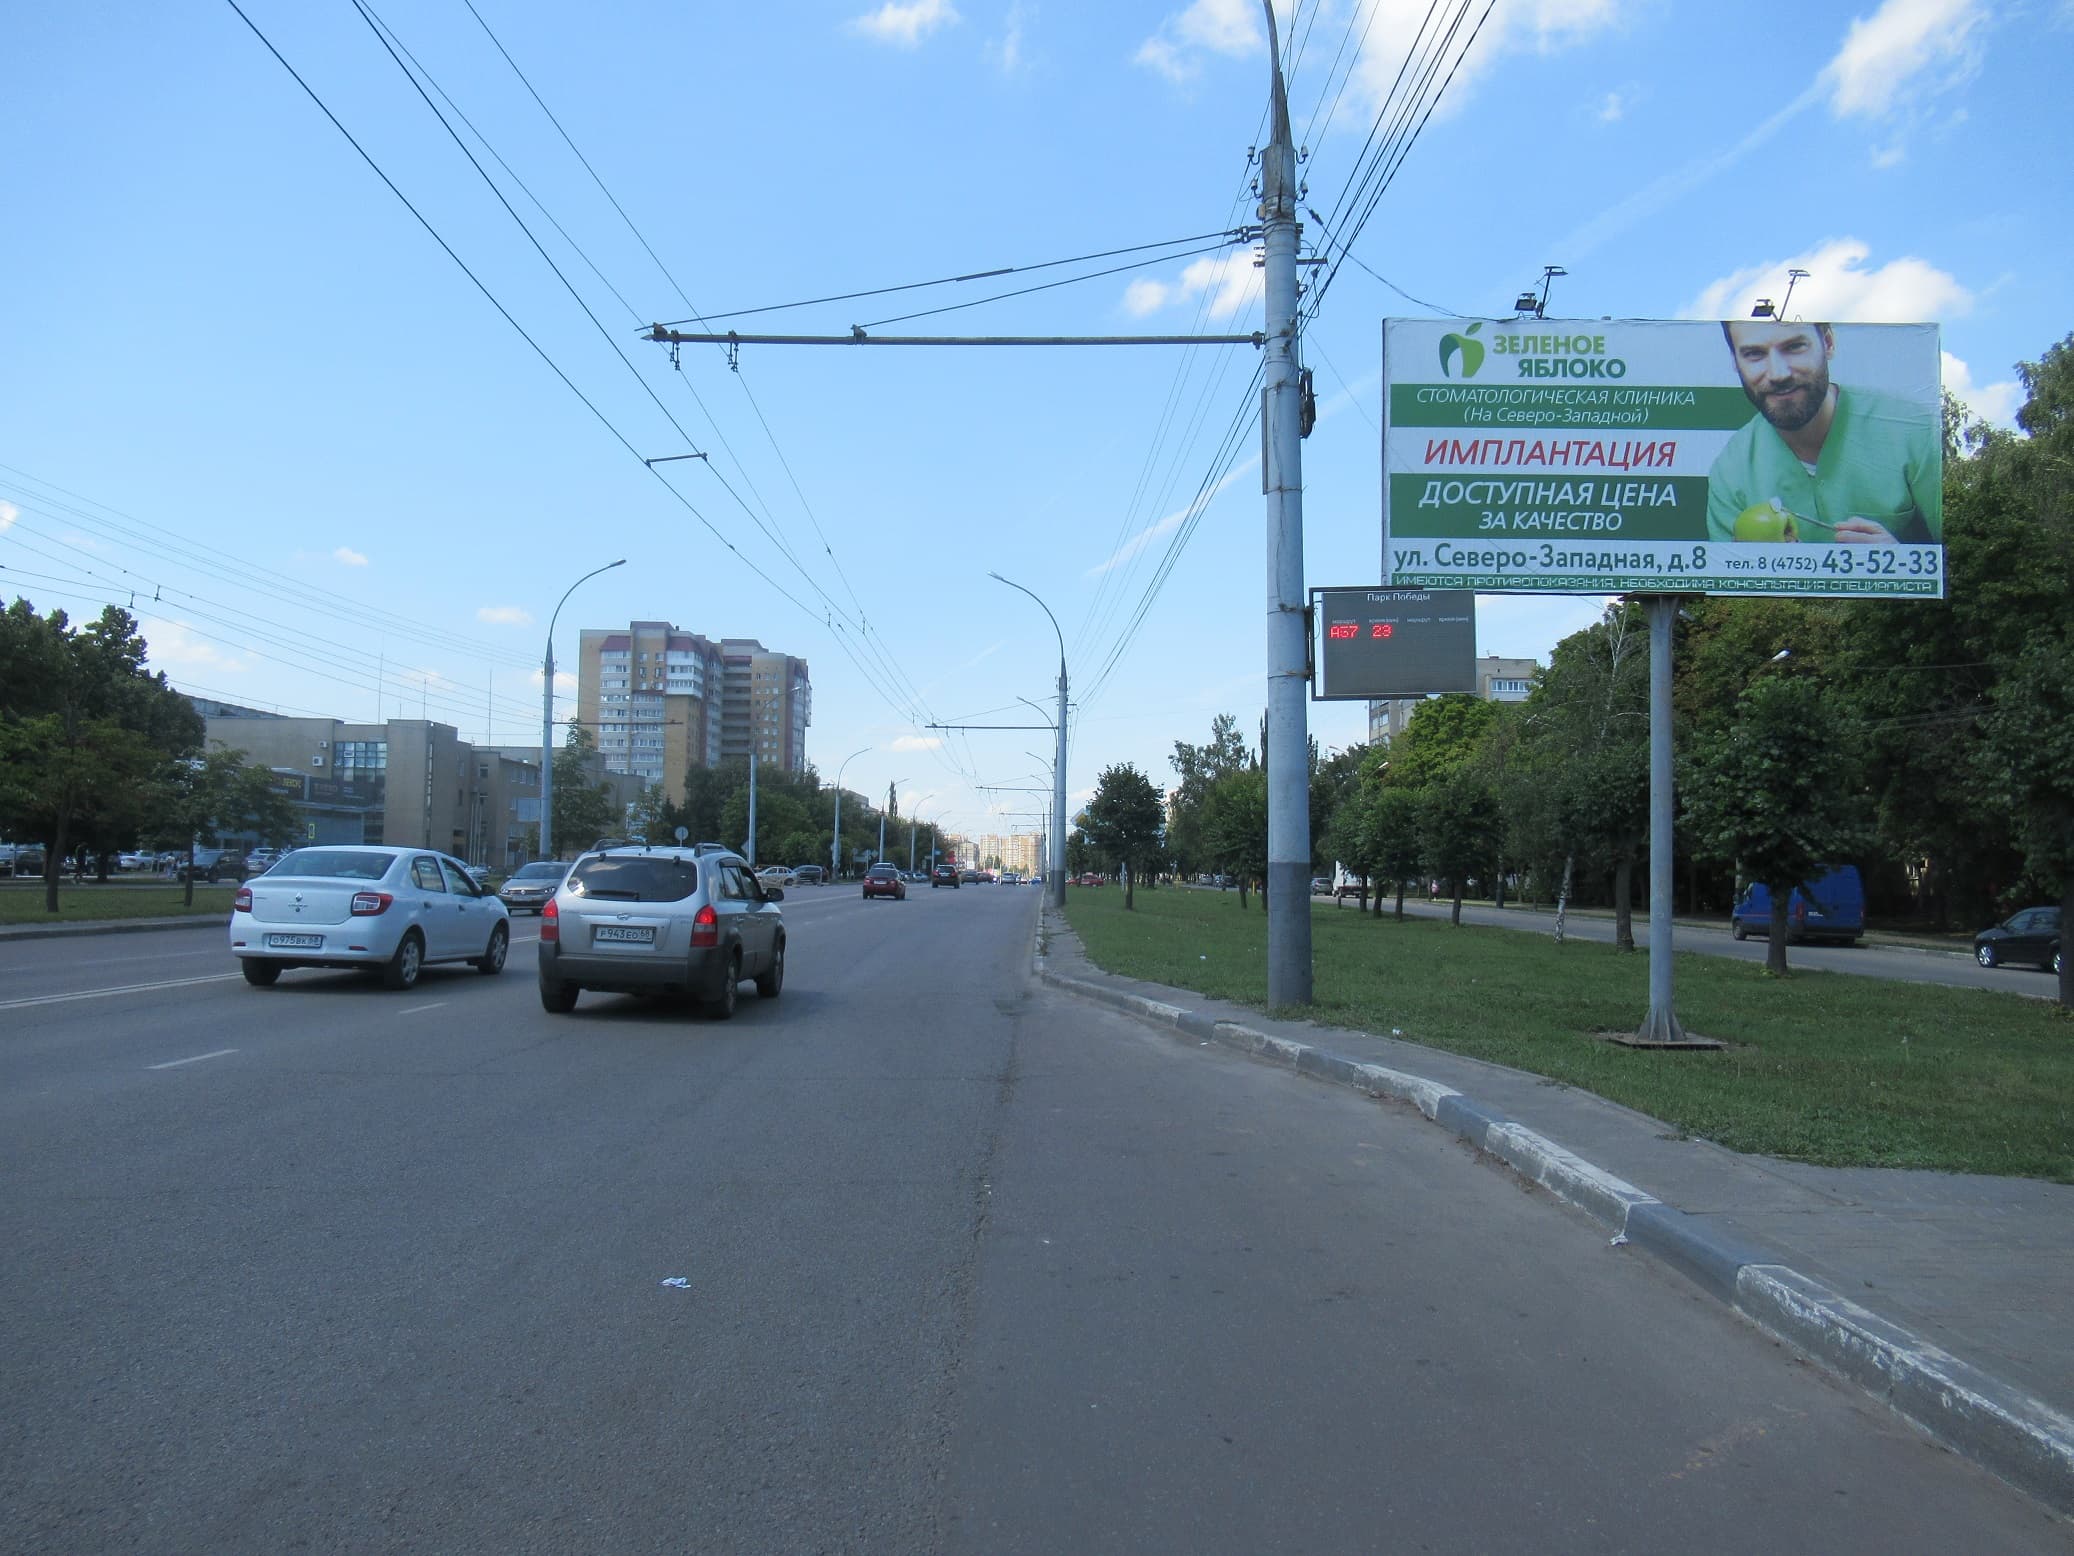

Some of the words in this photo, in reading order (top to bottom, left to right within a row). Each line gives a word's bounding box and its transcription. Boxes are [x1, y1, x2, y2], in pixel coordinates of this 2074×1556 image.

[1493, 335, 1605, 355] ЗЕЛЕНОЕ
[1518, 358, 1626, 378] ЯБЛОКО
[1416, 388, 1609, 405] СТОМАТОЛОГИЧЕСКАЯ
[1613, 390, 1696, 406] КЛИНИКА
[1463, 407, 1491, 423] (На
[1497, 407, 1649, 425] Северо-Западной)
[1424, 439, 1676, 471] ИМПЛАНТАЦИЯ
[1418, 481, 1594, 508] ДОСТУПНАЯ
[1600, 483, 1677, 510] ЦЕНА
[1478, 512, 1506, 529] ЗА
[1512, 512, 1622, 531] КАЧЕСТВО
[1394, 549, 1428, 572] ул.
[1434, 543, 1662, 573] Северо-Западная,
[1667, 546, 1707, 572] д.8
[1725, 559, 1754, 570] тел.
[1757, 557, 1767, 570] 8
[1771, 557, 1817, 573] (4752)
[1822, 549, 1938, 575] 43-52-33
[1396, 576, 1463, 586] ИМЕЮТСЯ
[1620, 578, 1715, 589] НЕОБХОДИМА
[1719, 580, 1828, 591] КОНСУЛЬТАЦИЯ
[1830, 581, 1933, 592] СПЕЦИАЛИСТА
[1367, 593, 1390, 603] Парк
[1392, 592, 1431, 601] Победы
[1372, 624, 1393, 638] 23
